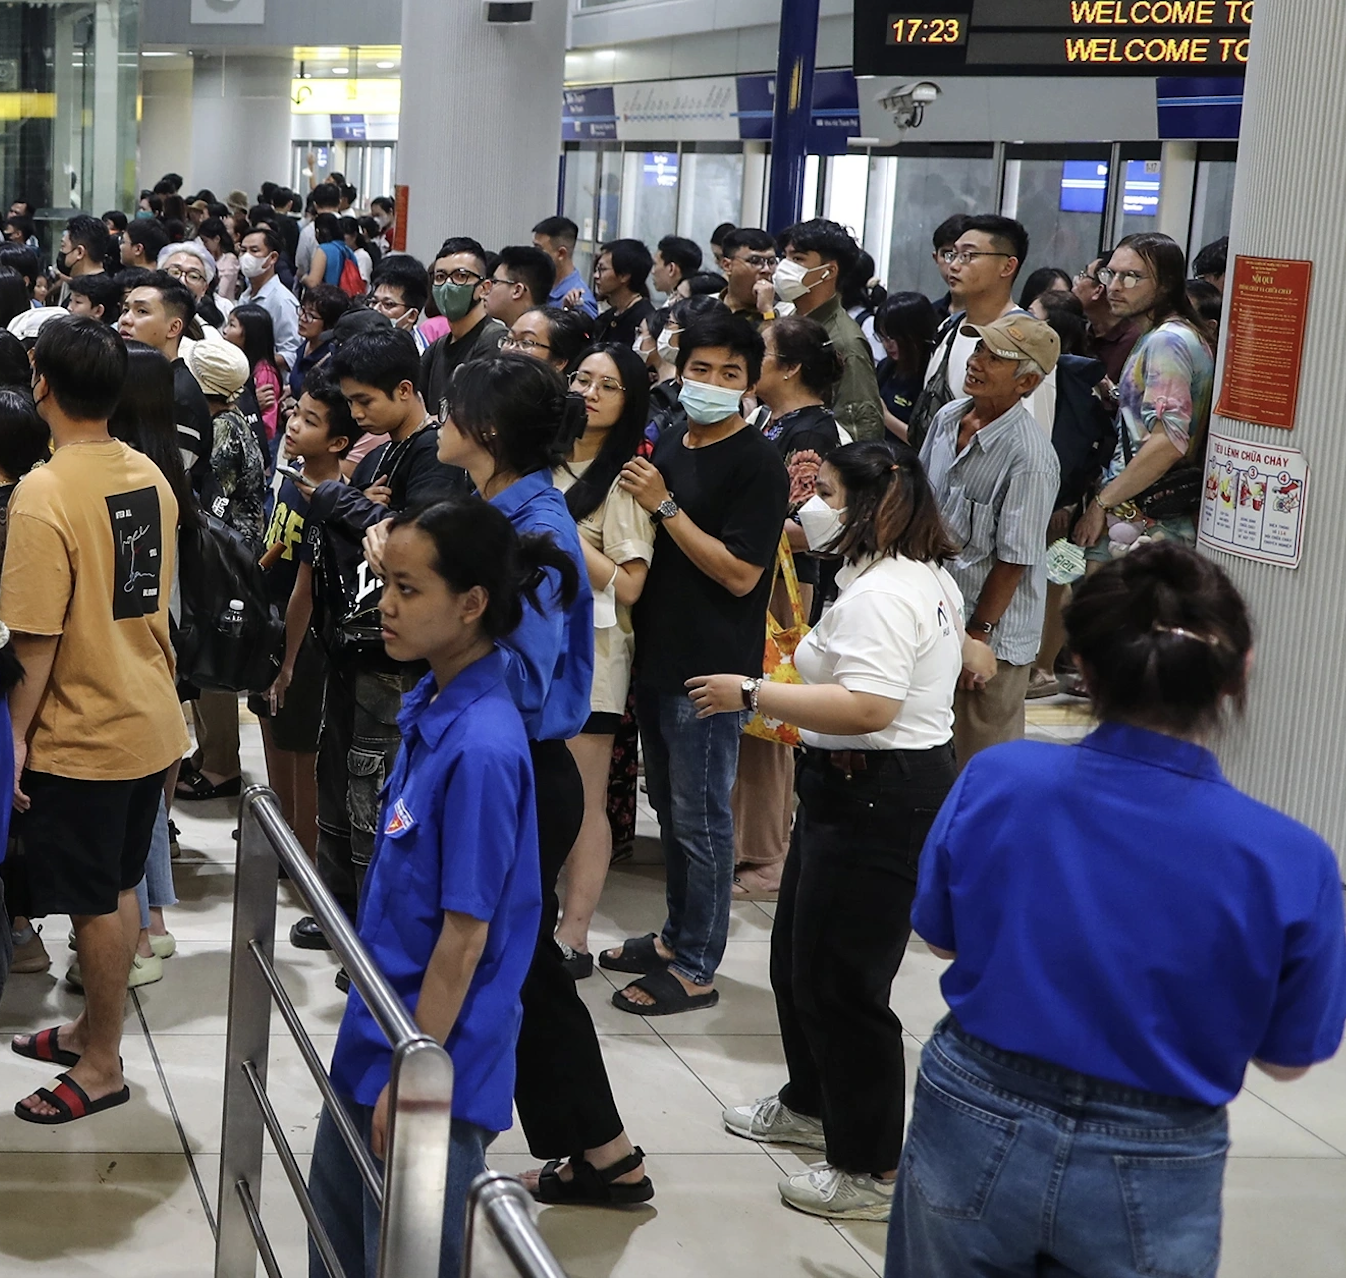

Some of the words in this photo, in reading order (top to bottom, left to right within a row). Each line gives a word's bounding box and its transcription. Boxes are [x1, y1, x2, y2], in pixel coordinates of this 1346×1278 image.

[1071, 1, 1212, 24] WELCOME
[892, 19, 959, 43] 17:23
[1065, 38, 1210, 62] WELCOME
[1241, 449, 1261, 463] CHỮA
[1264, 454, 1289, 467] CHÁY
